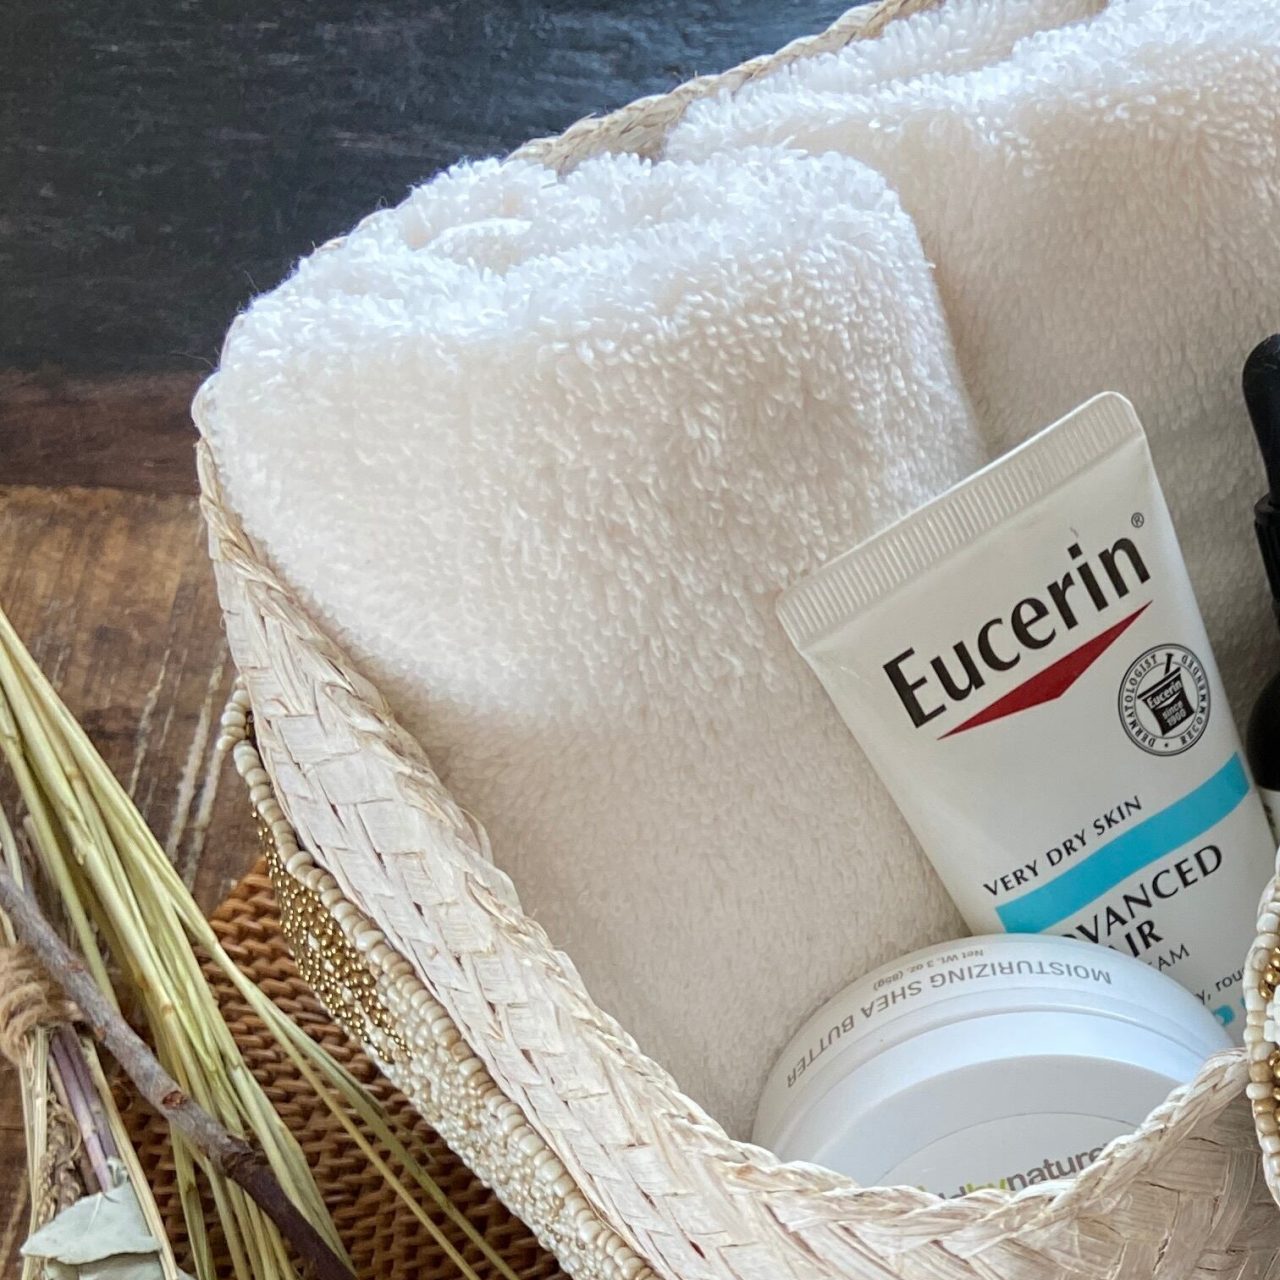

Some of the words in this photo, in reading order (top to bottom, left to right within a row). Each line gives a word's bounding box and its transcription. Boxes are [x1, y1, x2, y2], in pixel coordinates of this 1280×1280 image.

[1124, 653, 1158, 748] DERMATOLOGIST
[1146, 680, 1183, 709] Eucerin
[1180, 654, 1207, 746] RECOMMENDED
[1162, 700, 1184, 720] since
[983, 860, 1039, 896] VERY
[1045, 829, 1087, 866] DRY
[1093, 795, 1142, 836] SKIN
[1061, 845, 1223, 945] VANCED
[926, 960, 934, 968] 3
[962, 949, 984, 959] Net
[873, 970, 904, 991] (85g)
[931, 960, 1112, 988] MOISTURIZING
[1215, 967, 1245, 991] rou
[861, 981, 922, 1019] SHEA
[787, 1014, 855, 1089] BUTTER
